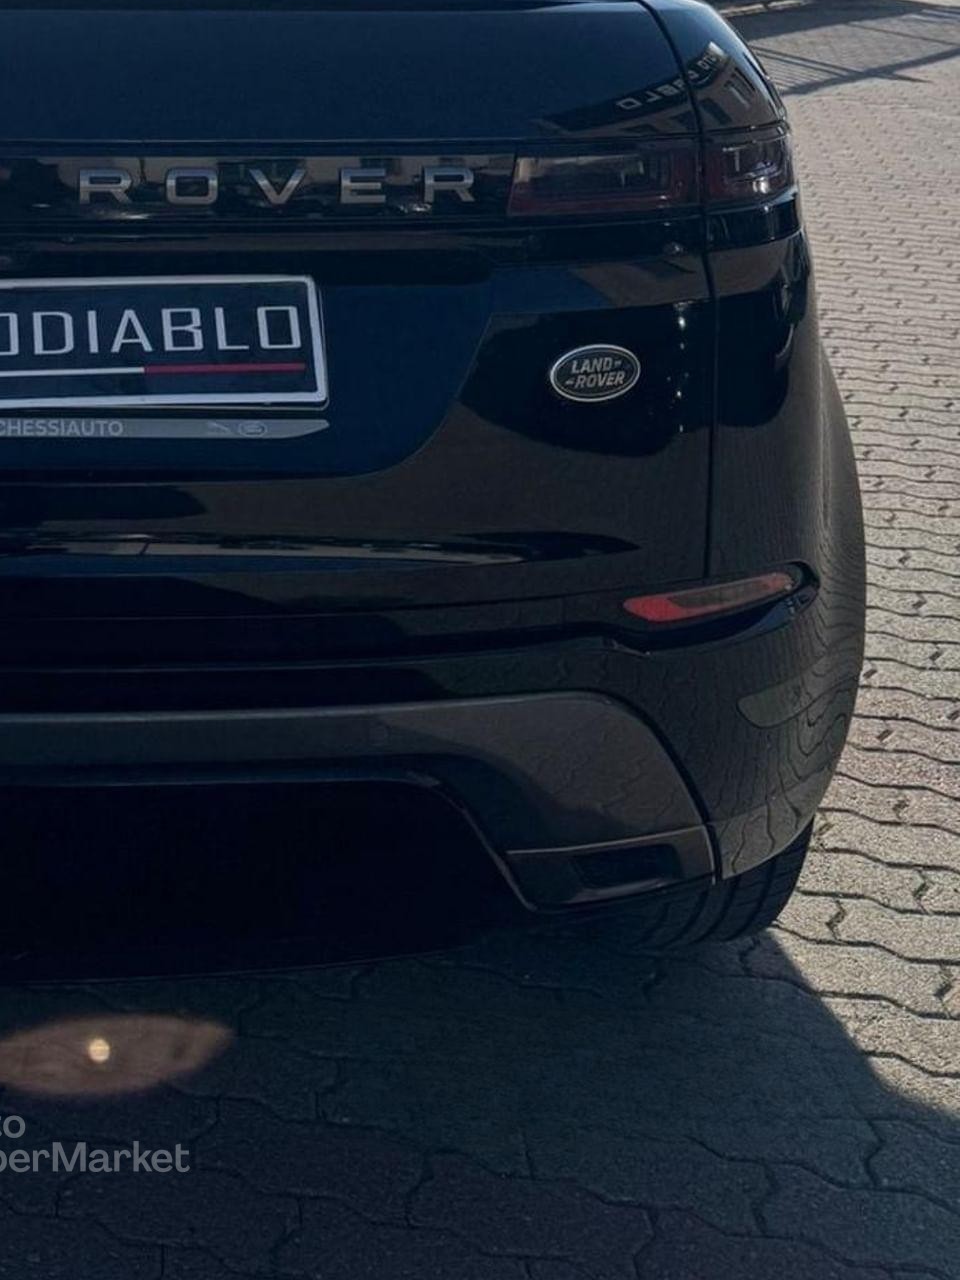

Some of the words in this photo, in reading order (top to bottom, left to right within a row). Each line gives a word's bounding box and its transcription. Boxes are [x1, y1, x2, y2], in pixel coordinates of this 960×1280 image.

[78, 166, 475, 206] ROVER
[572, 357, 613, 374] LAND
[574, 371, 625, 388] ROVER
